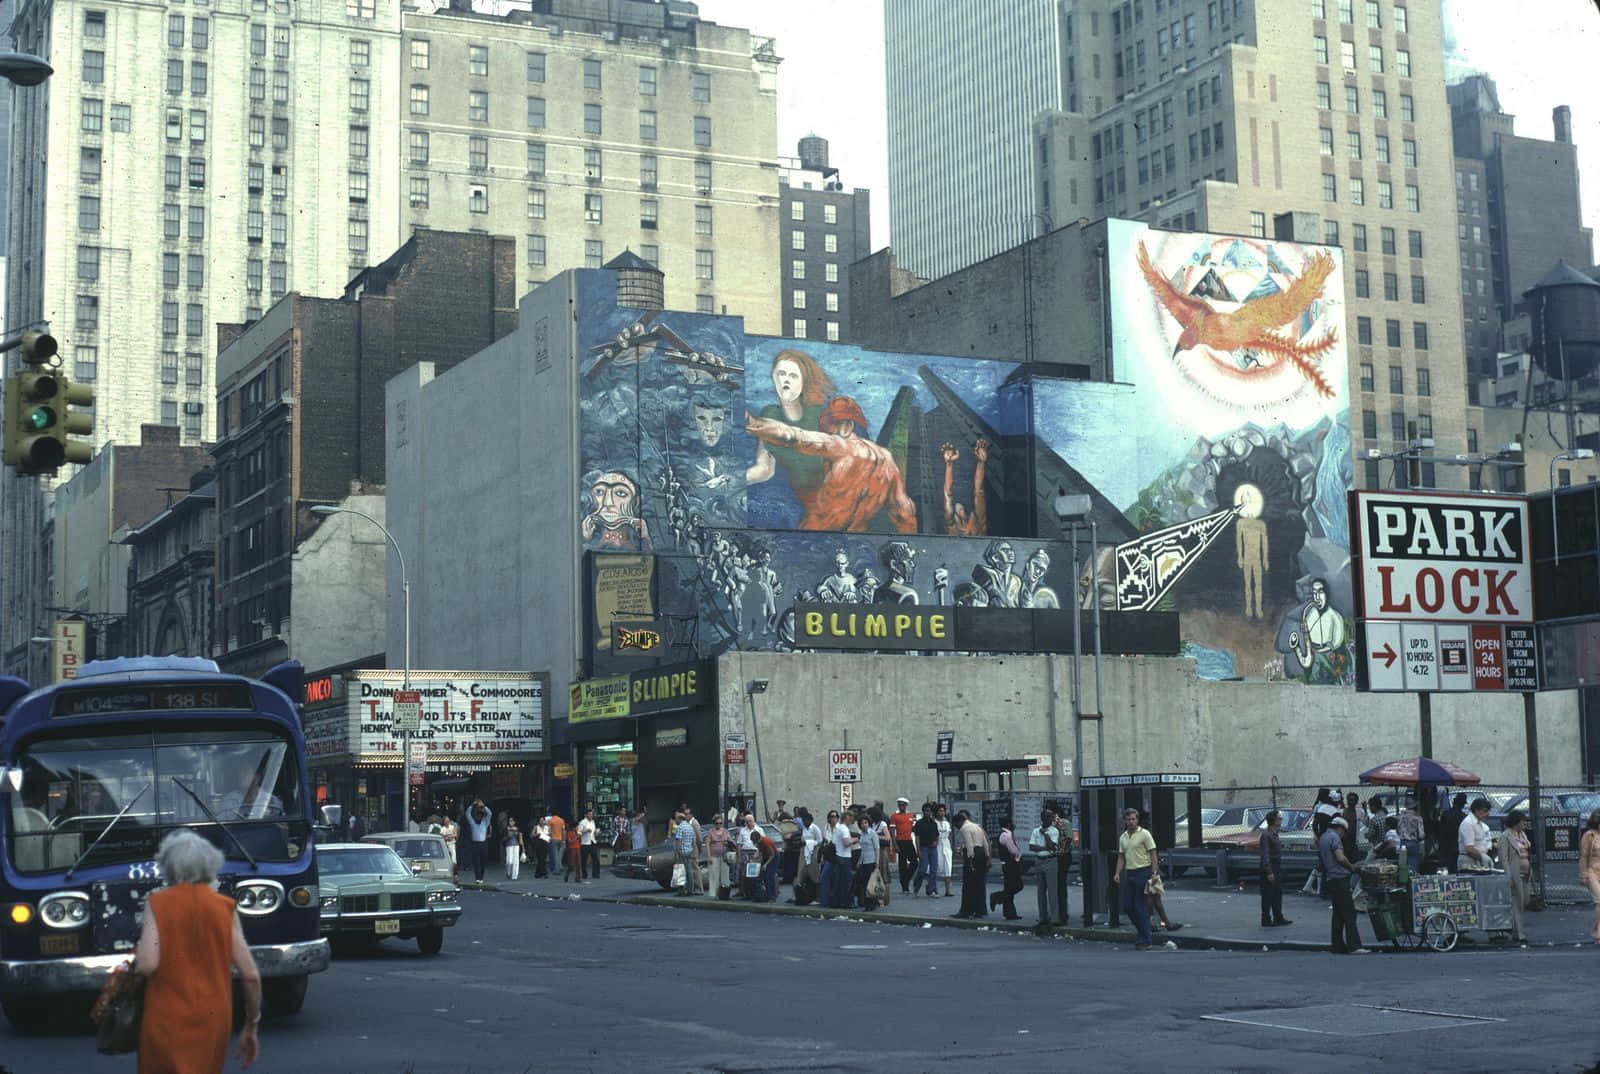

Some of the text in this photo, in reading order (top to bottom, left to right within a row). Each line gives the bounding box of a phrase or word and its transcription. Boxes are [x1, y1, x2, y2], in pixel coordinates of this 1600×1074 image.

[1373, 506, 1517, 558] PARK
[1377, 566, 1519, 616] LOCK
[806, 611, 946, 639] BLIMPIE
[1410, 639, 1428, 648] UP TO
[1474, 639, 1500, 650] OPEN
[1406, 652, 1435, 662] 10 HOURS
[1481, 652, 1495, 664] 24
[1413, 664, 1429, 675] 4.72
[1475, 667, 1502, 678] HOURS
[361, 683, 398, 697] DONN
[471, 683, 543, 697] COMMODORES
[586, 680, 628, 697] Panasonic
[633, 671, 697, 703] BLIMPIE
[168, 694, 194, 707] 138
[360, 723, 393, 733] HENRY
[441, 723, 496, 733] SYLVESTER
[495, 729, 543, 738] STALLONE
[443, 741, 457, 750] OF
[832, 752, 858, 764] OPEN
[1545, 817, 1578, 827] SQUARE
